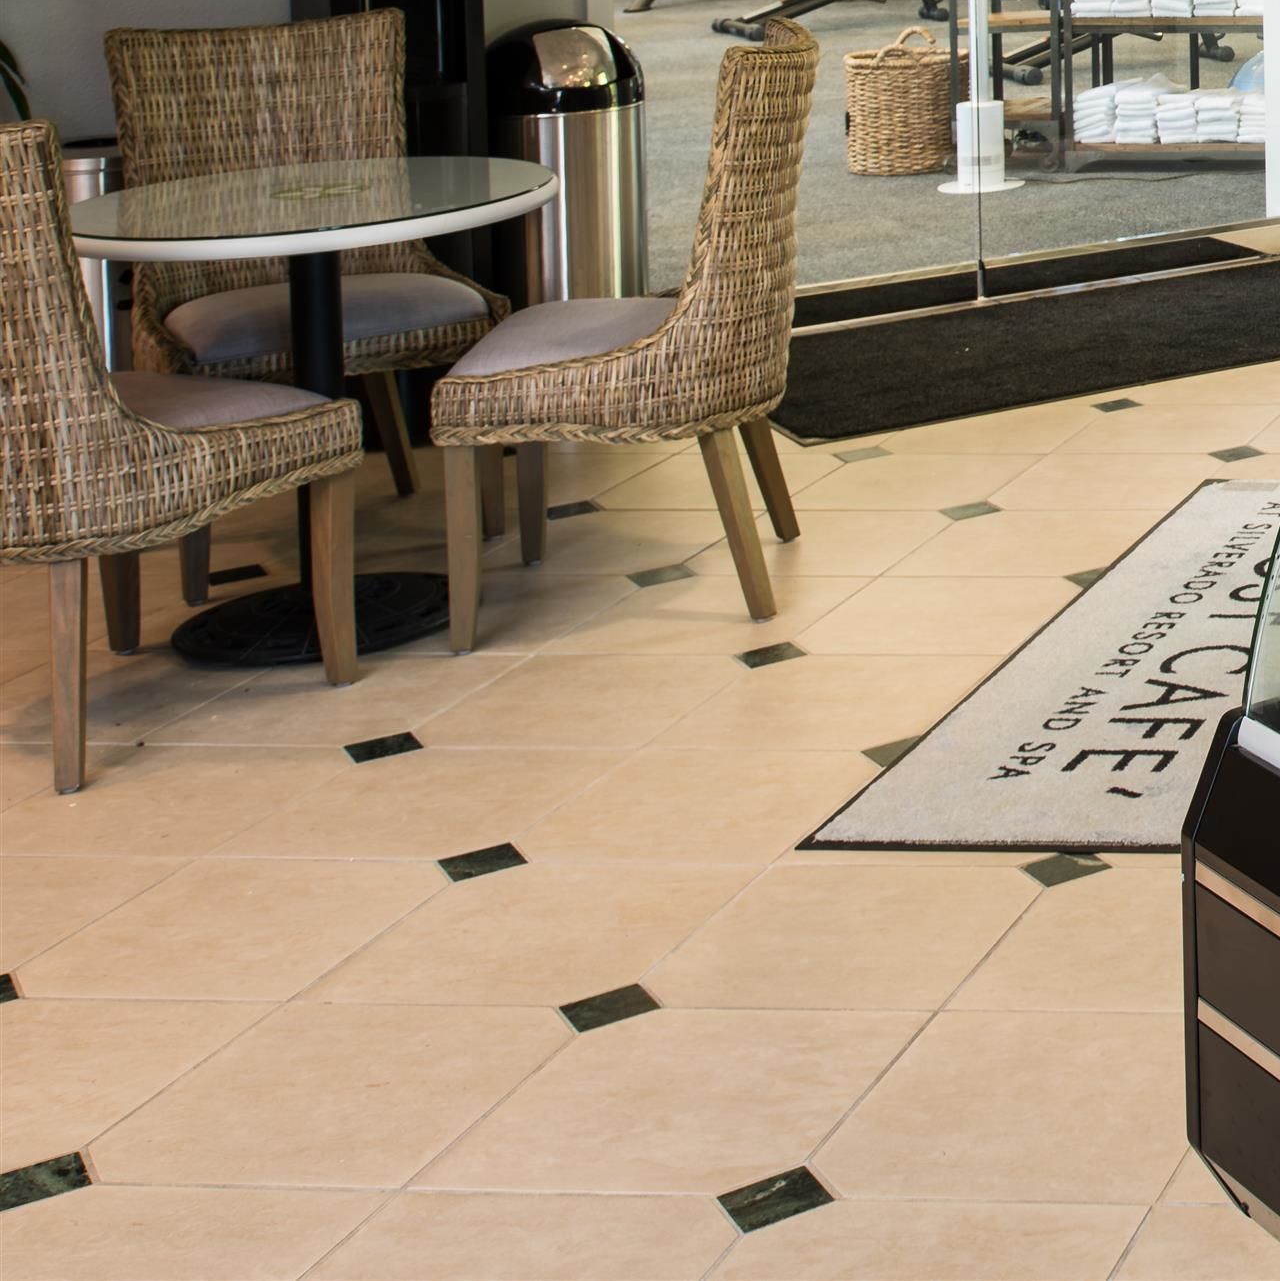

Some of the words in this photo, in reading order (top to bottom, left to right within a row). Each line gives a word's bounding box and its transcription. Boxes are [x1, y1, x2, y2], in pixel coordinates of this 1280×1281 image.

[1169, 522, 1273, 605] SILVERADO
[1095, 611, 1187, 679] RESORT
[1042, 686, 1108, 732] AND
[987, 741, 1056, 780] SPA
